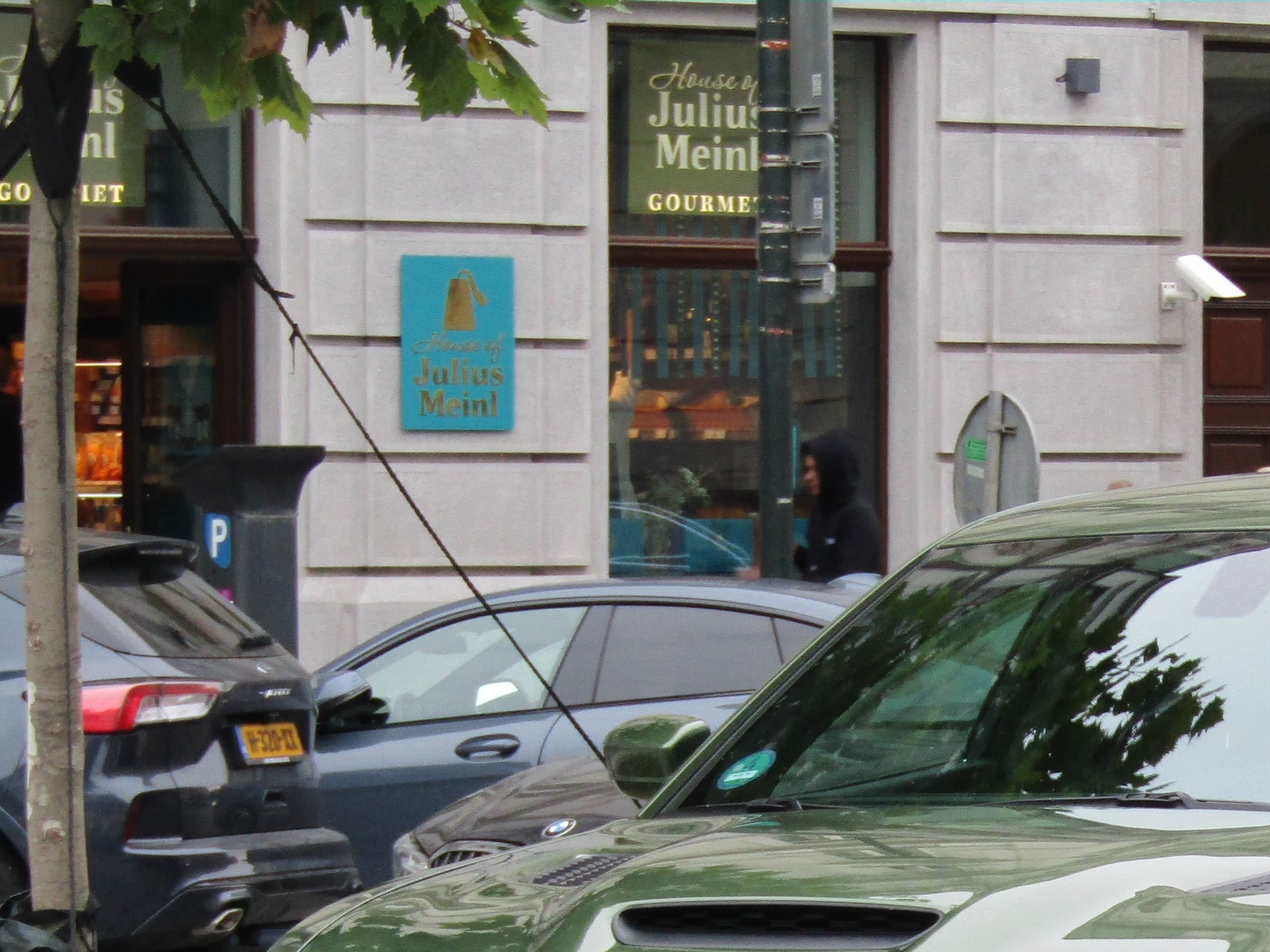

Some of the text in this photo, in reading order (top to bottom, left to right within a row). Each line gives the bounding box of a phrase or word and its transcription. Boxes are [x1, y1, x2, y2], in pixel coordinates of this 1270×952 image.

[649, 62, 738, 90] House
[412, 332, 505, 364] House of
[413, 357, 505, 386] Julius
[420, 389, 499, 418] Meinl
[211, 519, 228, 558] P
